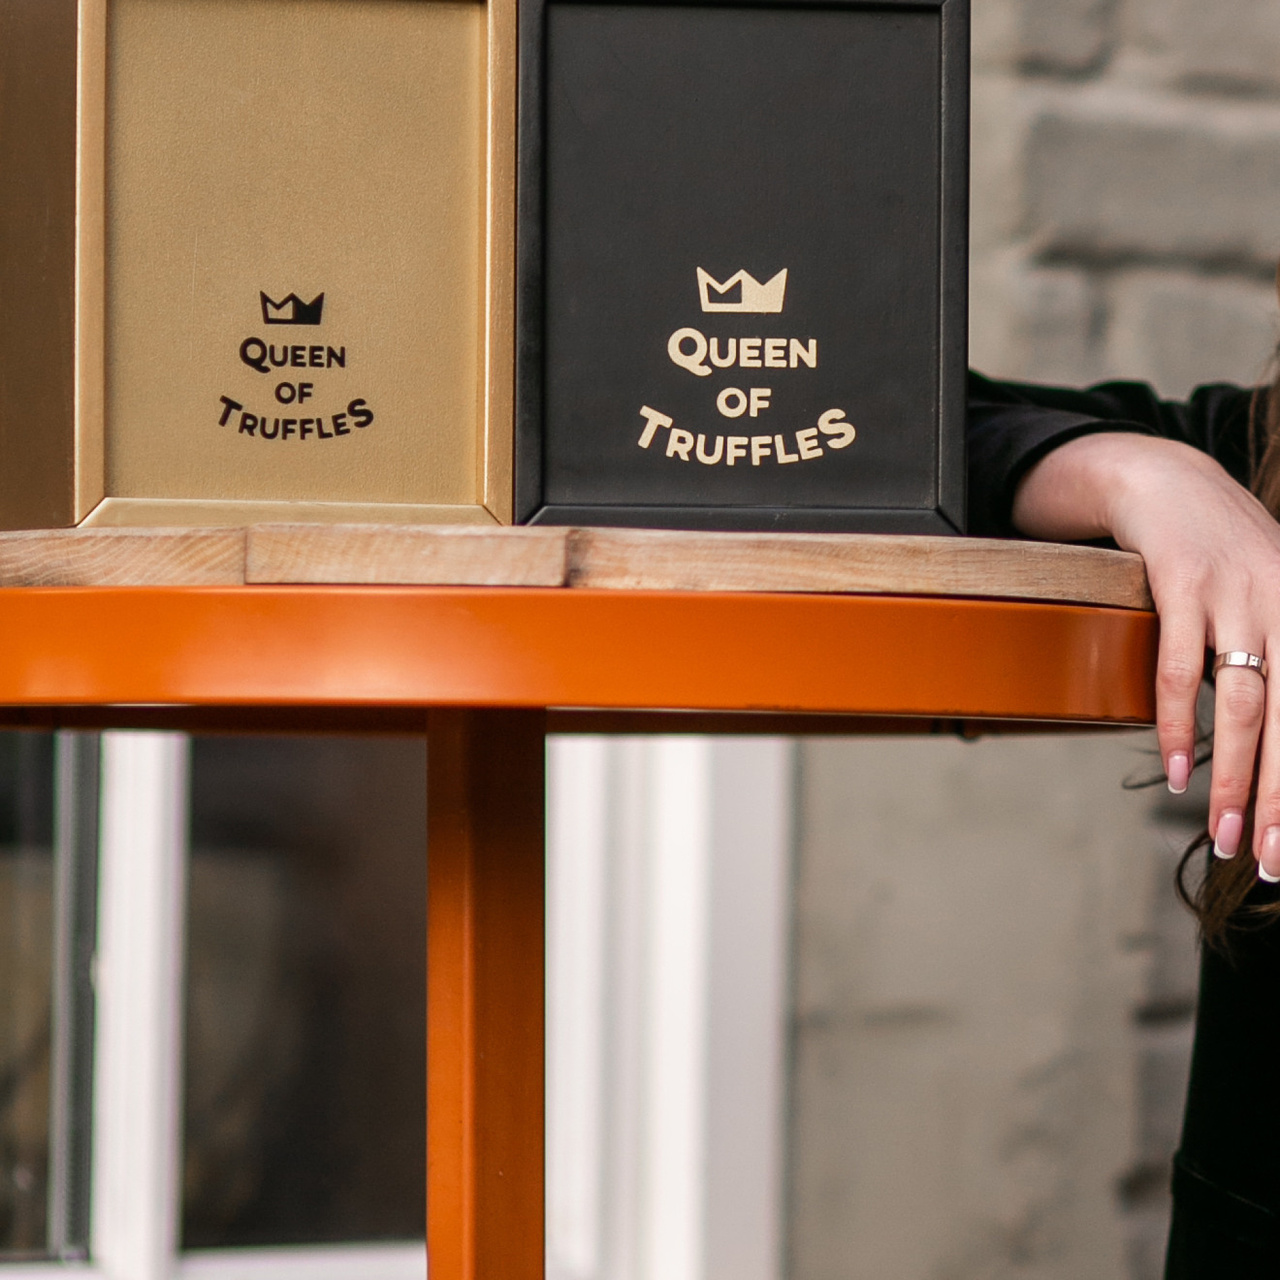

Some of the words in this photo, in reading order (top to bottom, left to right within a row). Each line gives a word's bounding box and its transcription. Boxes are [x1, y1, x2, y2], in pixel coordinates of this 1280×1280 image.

[239, 336, 346, 374] QUEEN
[667, 327, 817, 377] QUEEN
[274, 381, 314, 405] OF
[716, 387, 772, 418] OF
[218, 395, 374, 440] TRUFFLES
[638, 405, 856, 466] TRUFFLES
